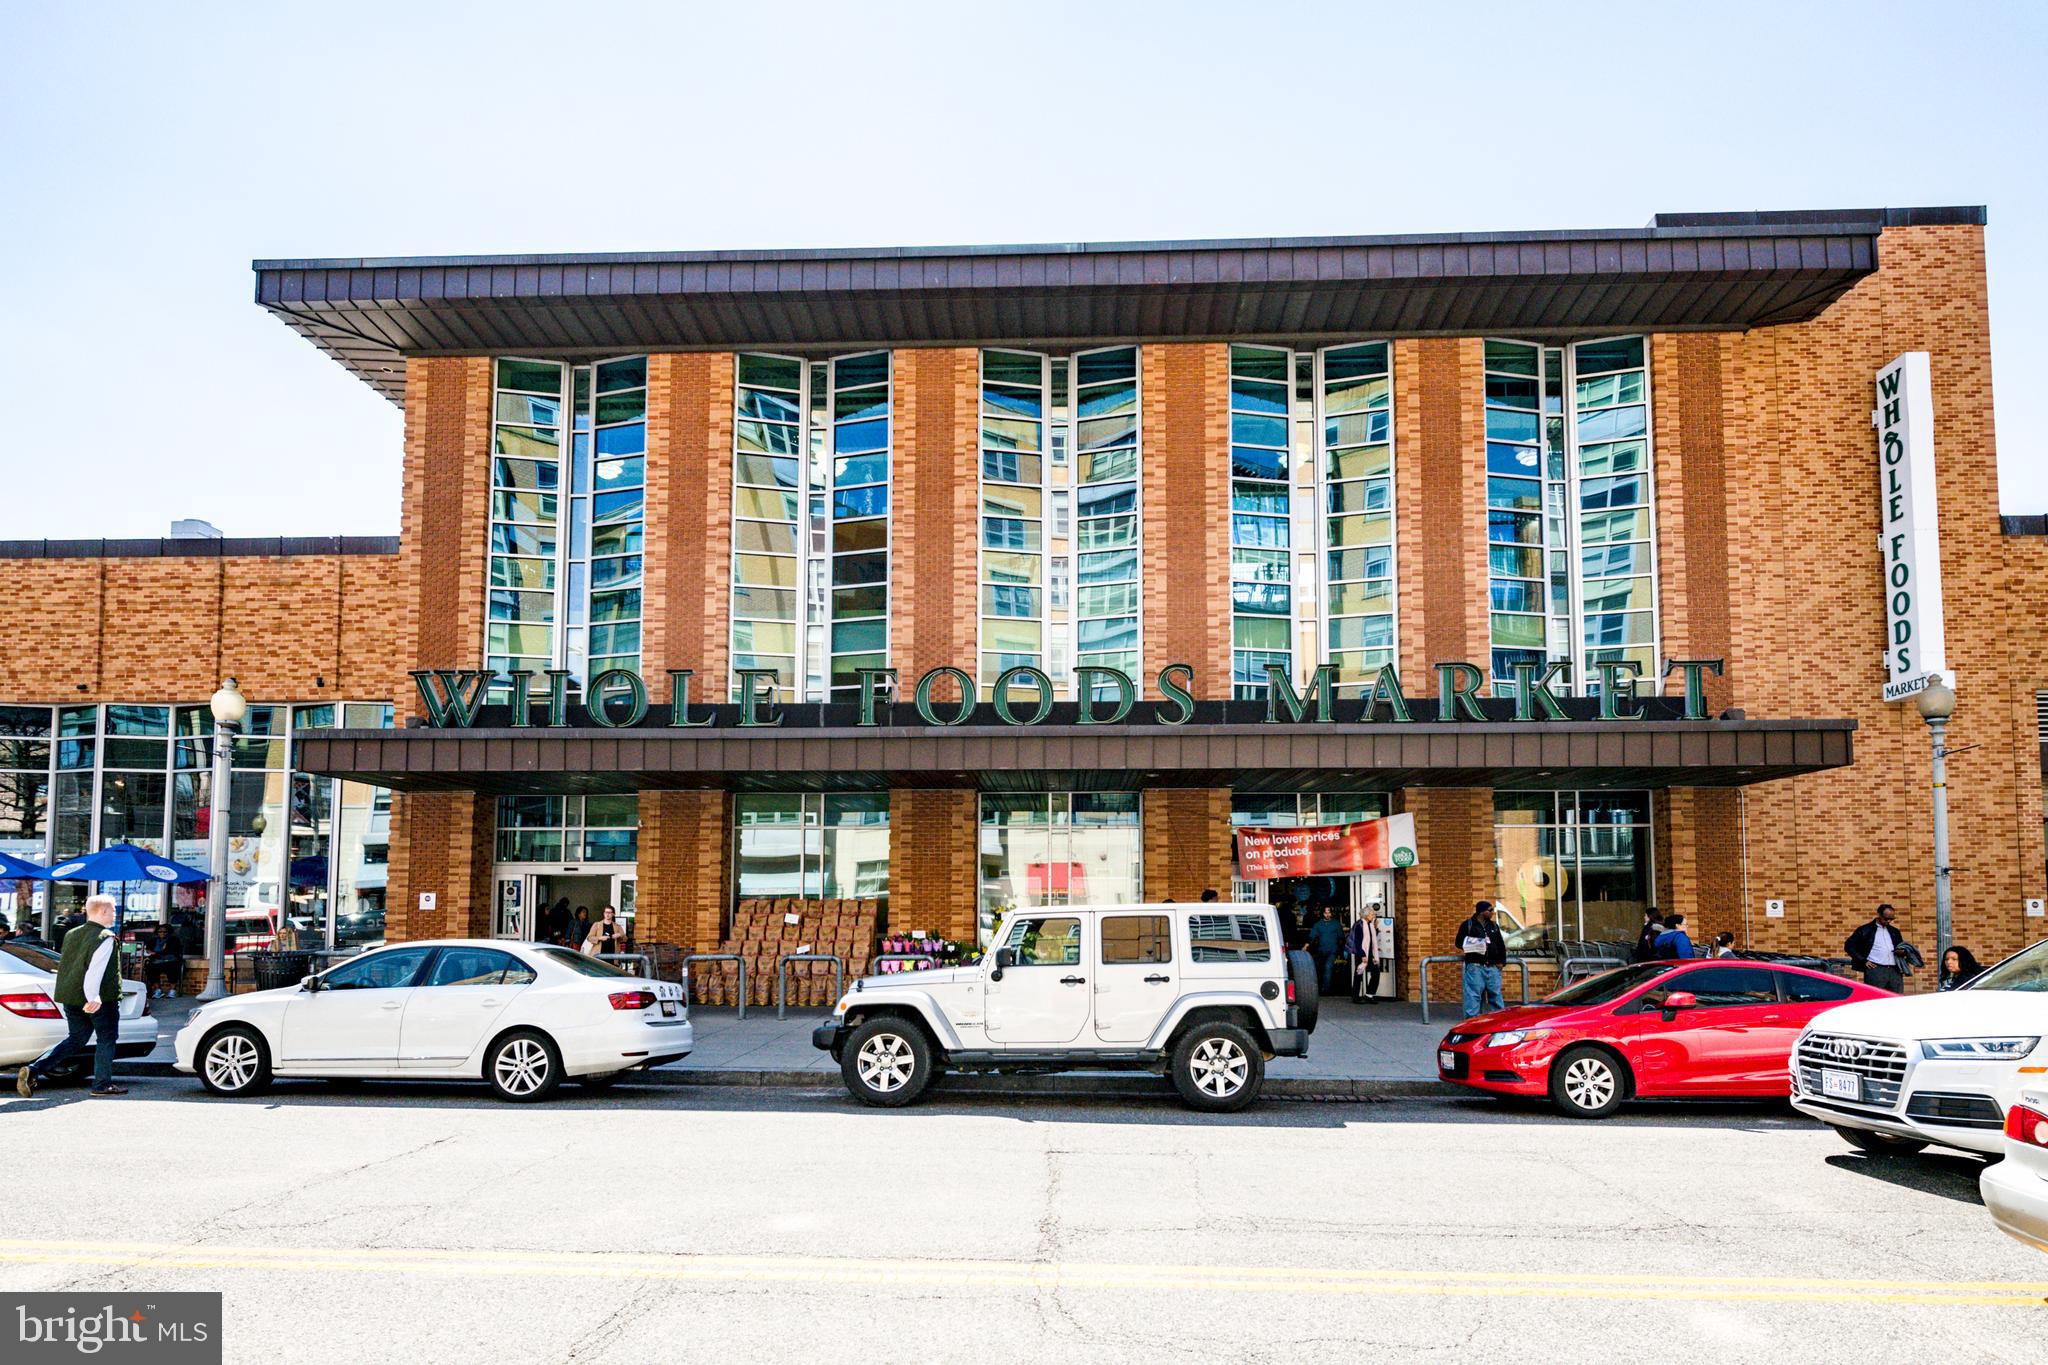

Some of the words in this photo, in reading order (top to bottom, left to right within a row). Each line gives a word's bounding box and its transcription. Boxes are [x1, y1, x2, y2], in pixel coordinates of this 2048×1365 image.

[1878, 368, 1904, 523] WHOLE
[1890, 533, 1912, 674] FOODS
[408, 668, 785, 728] WHOLE
[854, 664, 1195, 726] FOODS
[1261, 658, 1725, 723] MARKET
[1886, 676, 1927, 698] MARKET
[1244, 835, 1270, 847] New
[1272, 833, 1303, 845] lower
[1305, 831, 1341, 845] prices
[1245, 851, 1260, 859] on
[1263, 846, 1312, 860] produce.
[1246, 863, 1262, 872] (This
